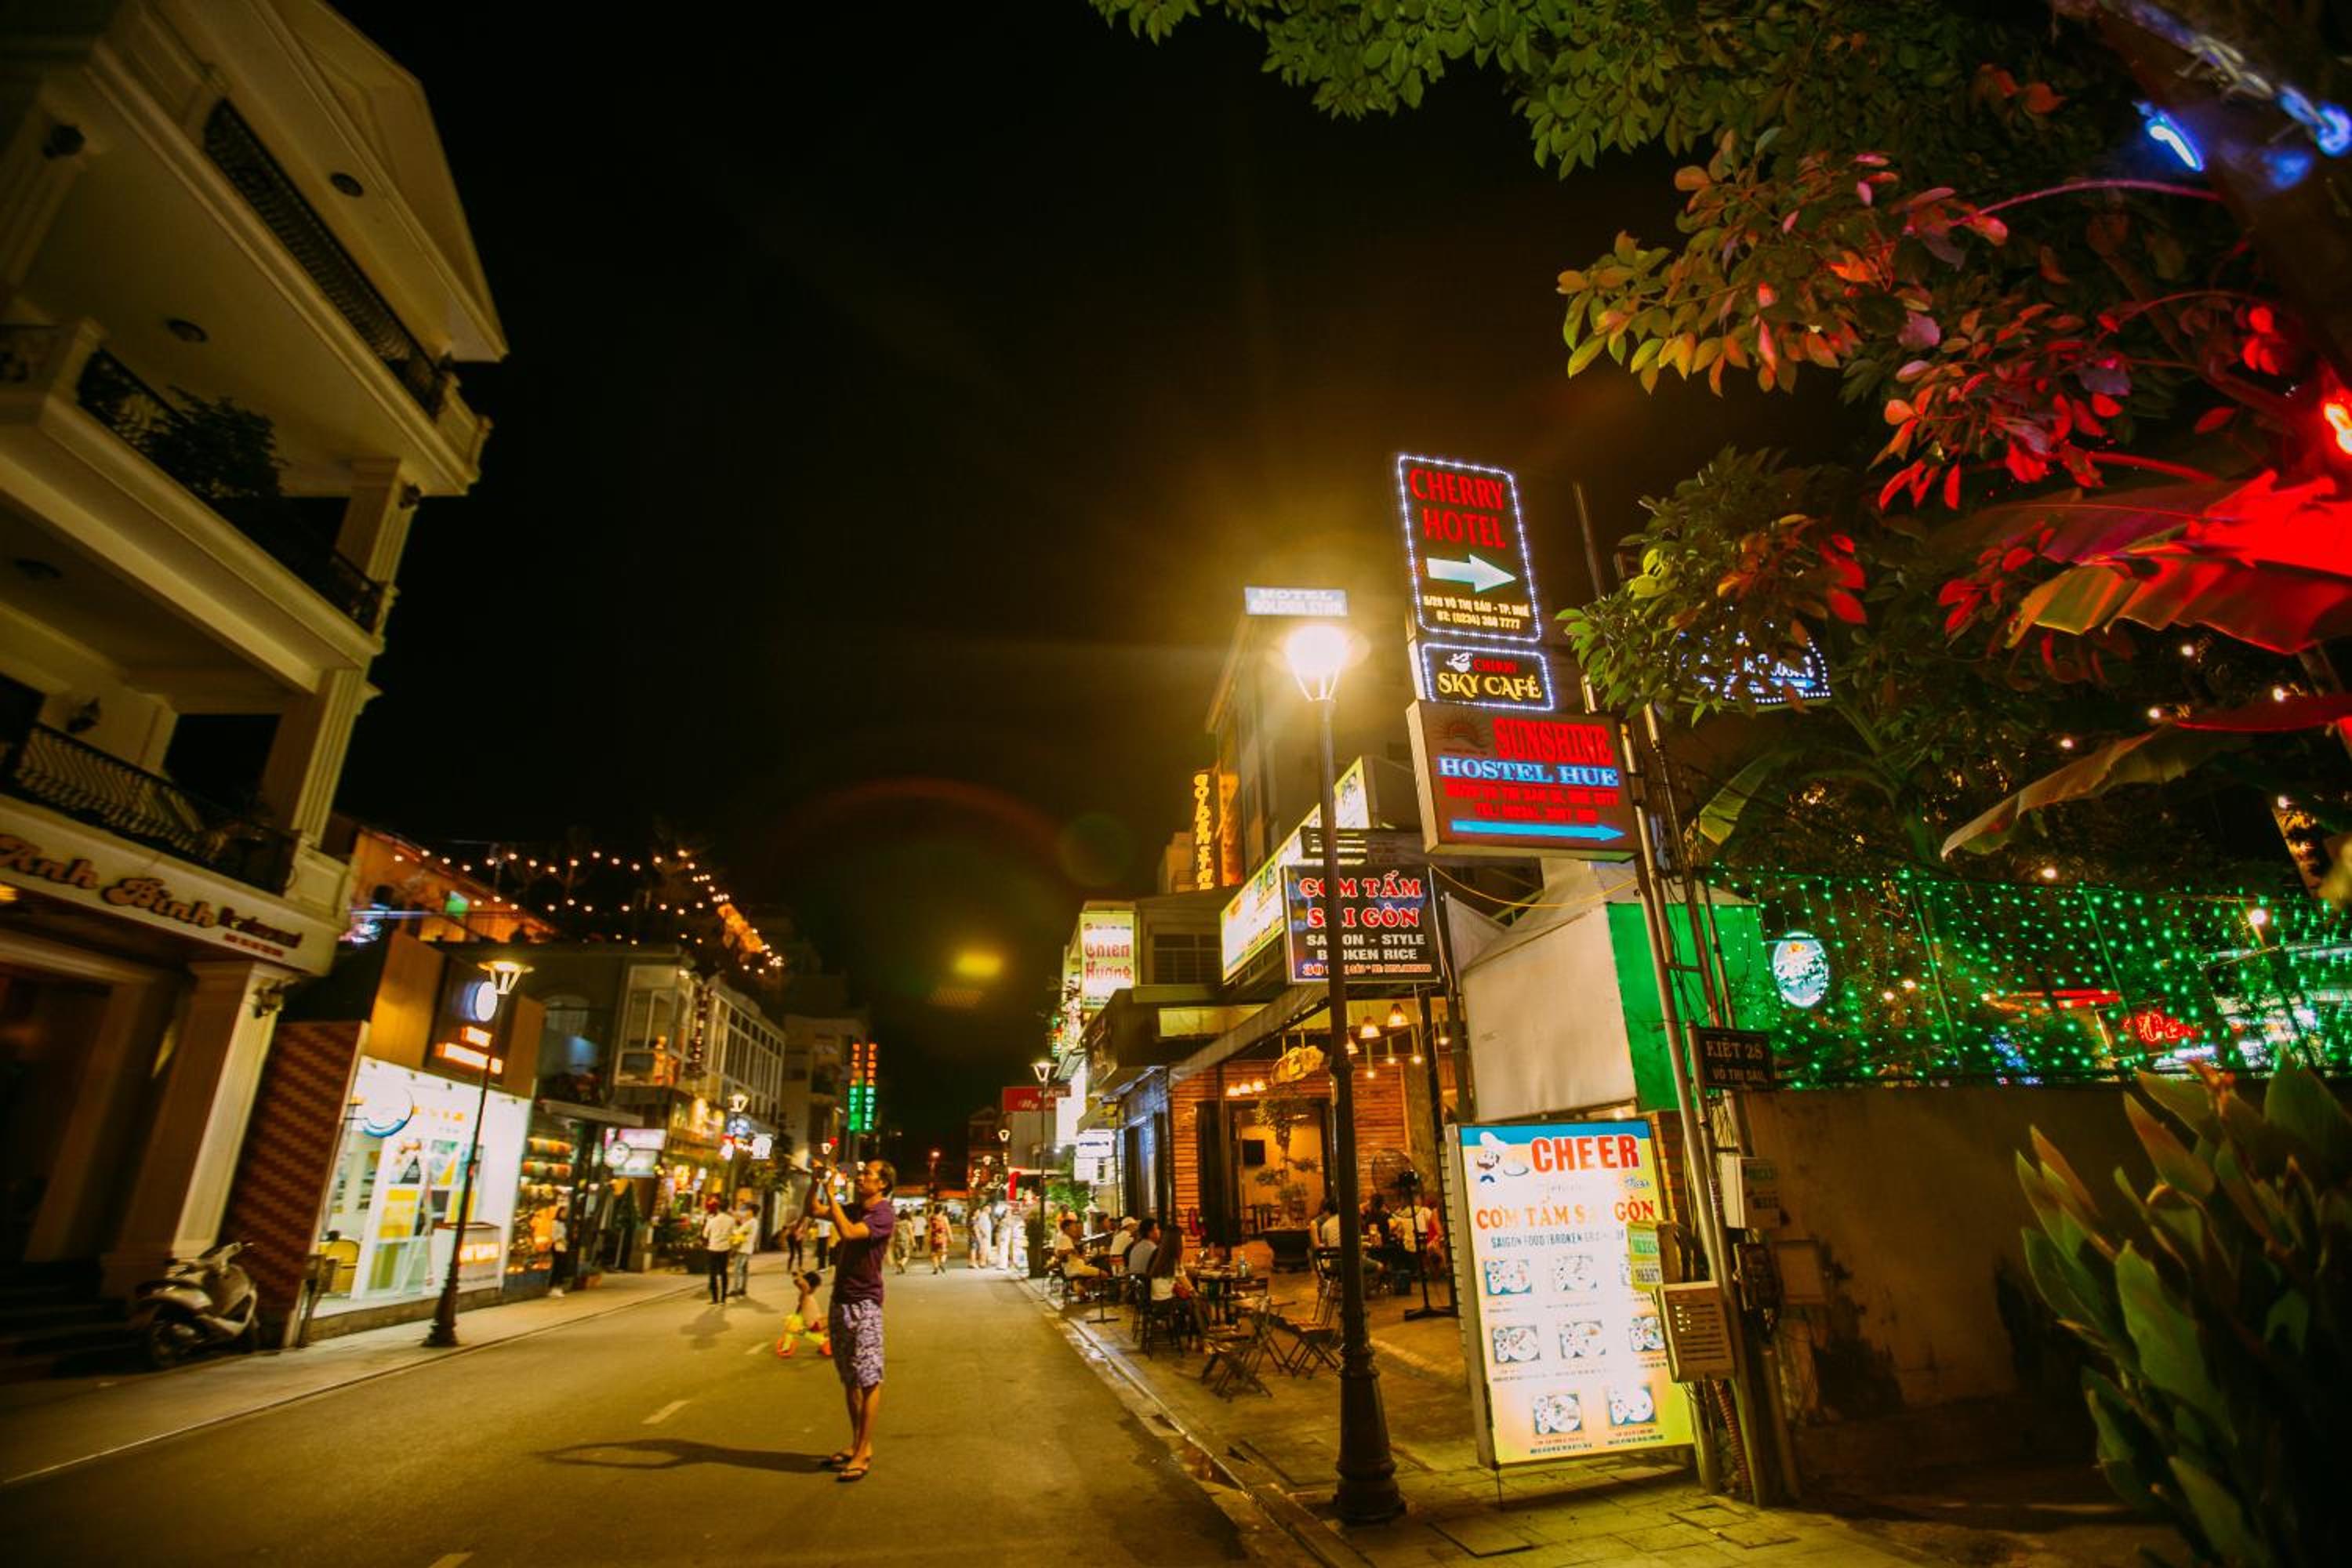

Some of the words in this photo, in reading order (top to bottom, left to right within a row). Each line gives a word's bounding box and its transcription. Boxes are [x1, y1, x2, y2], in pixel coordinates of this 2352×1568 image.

[1409, 468, 1504, 510] CHERRY
[1422, 507, 1506, 549] HOTEL
[1499, 617, 1520, 629] 7777
[1438, 672, 1479, 698] SKY
[1484, 675, 1542, 701] CAFÉ
[1493, 717, 1614, 765] SUNSHINE
[1439, 756, 1553, 783] HOSTEL
[1557, 765, 1619, 786] HUE
[1307, 908, 1356, 928] SI
[1306, 934, 1364, 946] SAON
[1381, 934, 1425, 946] STYLE
[1316, 949, 1379, 960] BKEN
[1384, 949, 1418, 960] RICE
[864, 1087, 876, 1130] HOTEL
[1531, 1134, 1640, 1174] CHEER
